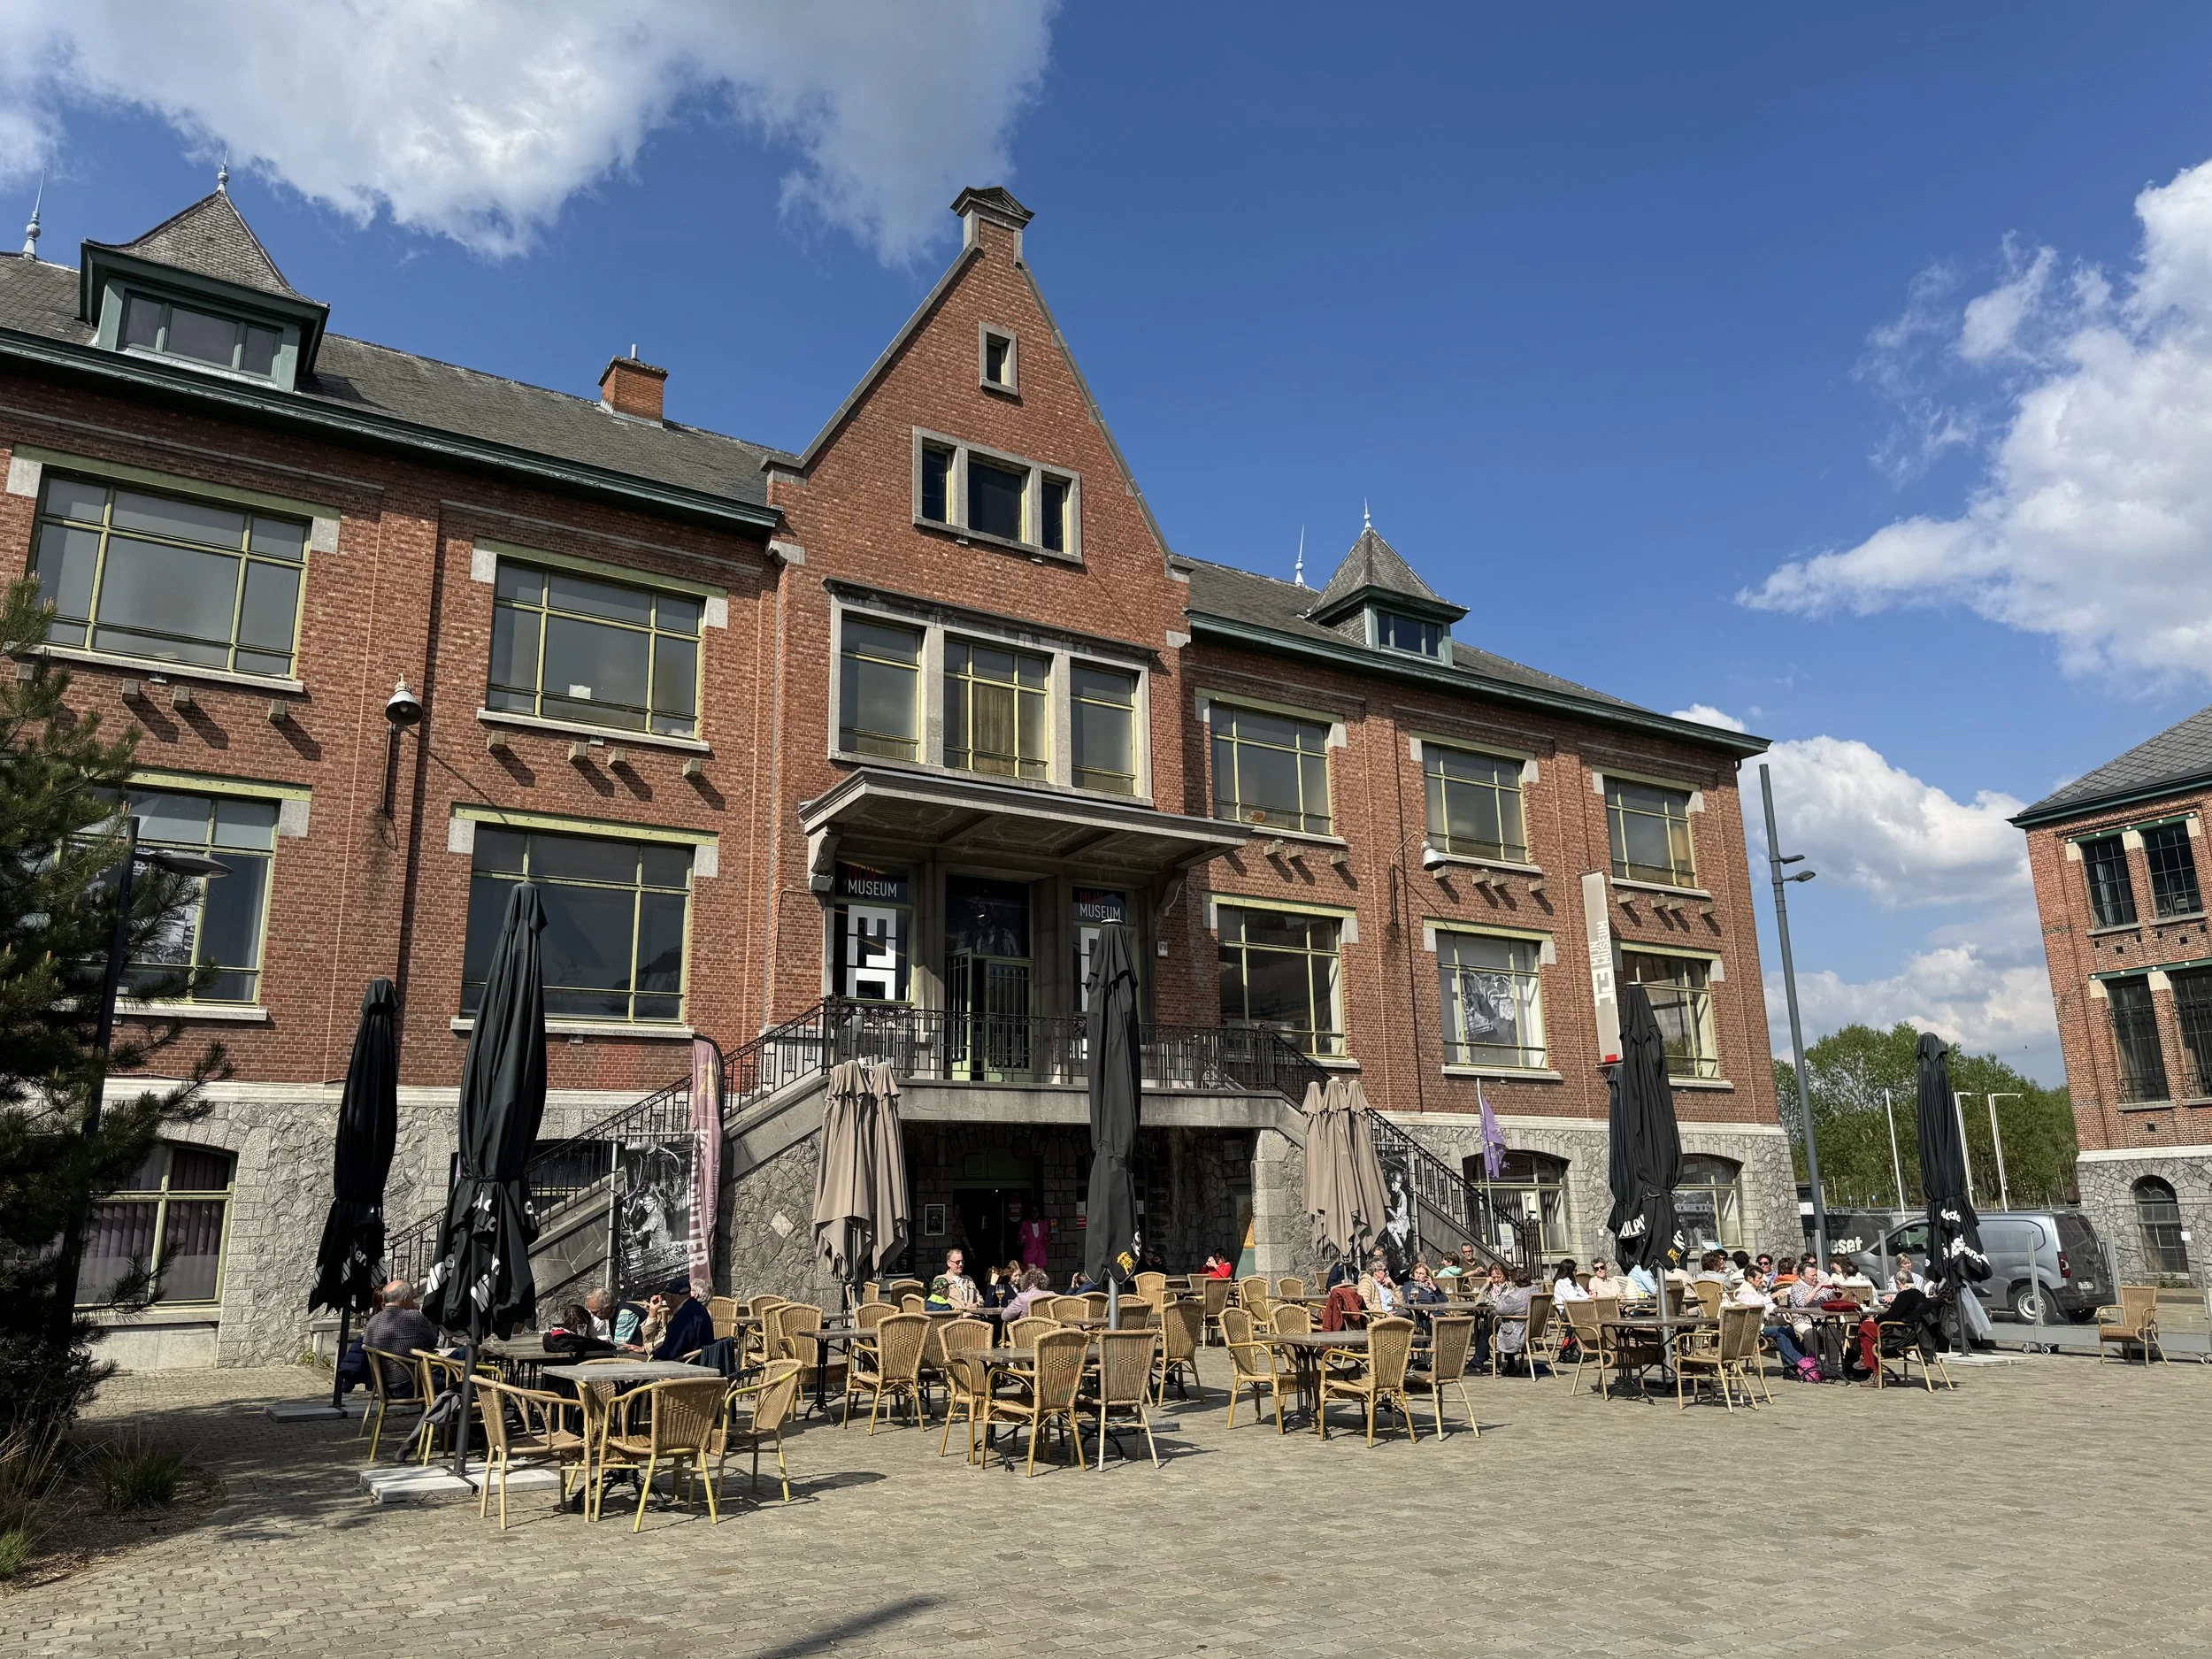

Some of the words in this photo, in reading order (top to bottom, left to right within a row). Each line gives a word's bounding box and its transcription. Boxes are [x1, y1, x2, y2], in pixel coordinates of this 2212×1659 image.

[849, 879, 896, 897] MUSEUM
[1079, 903, 1121, 920] MUSEUM
[1596, 920, 1610, 964] MUSEUM
